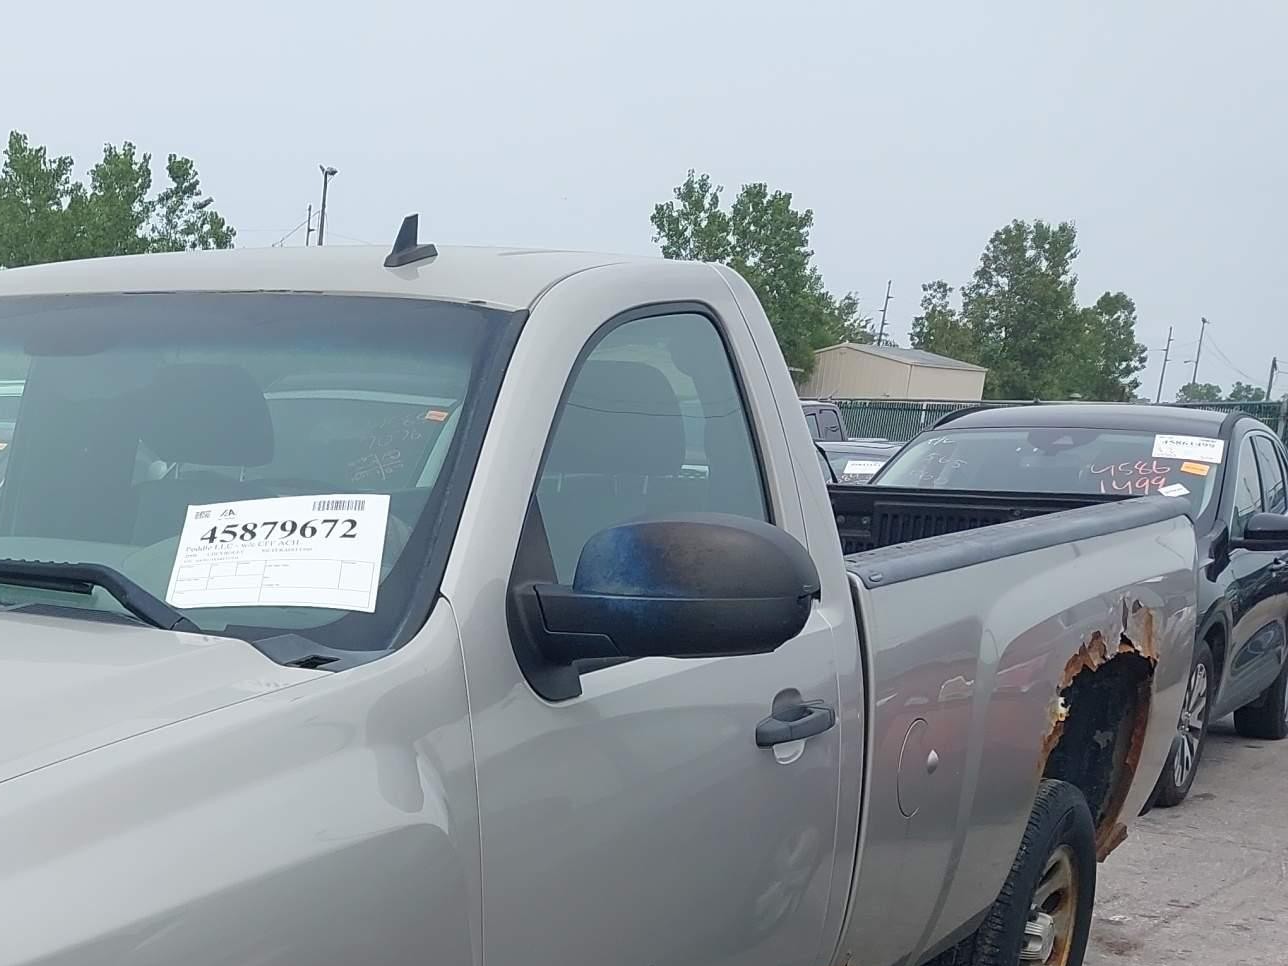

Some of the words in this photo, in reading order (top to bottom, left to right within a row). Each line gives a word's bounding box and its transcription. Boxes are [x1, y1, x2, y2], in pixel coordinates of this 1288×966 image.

[1090, 460, 1171, 476] 4586
[1099, 476, 1167, 496] 1499
[199, 518, 358, 544] 45879672
